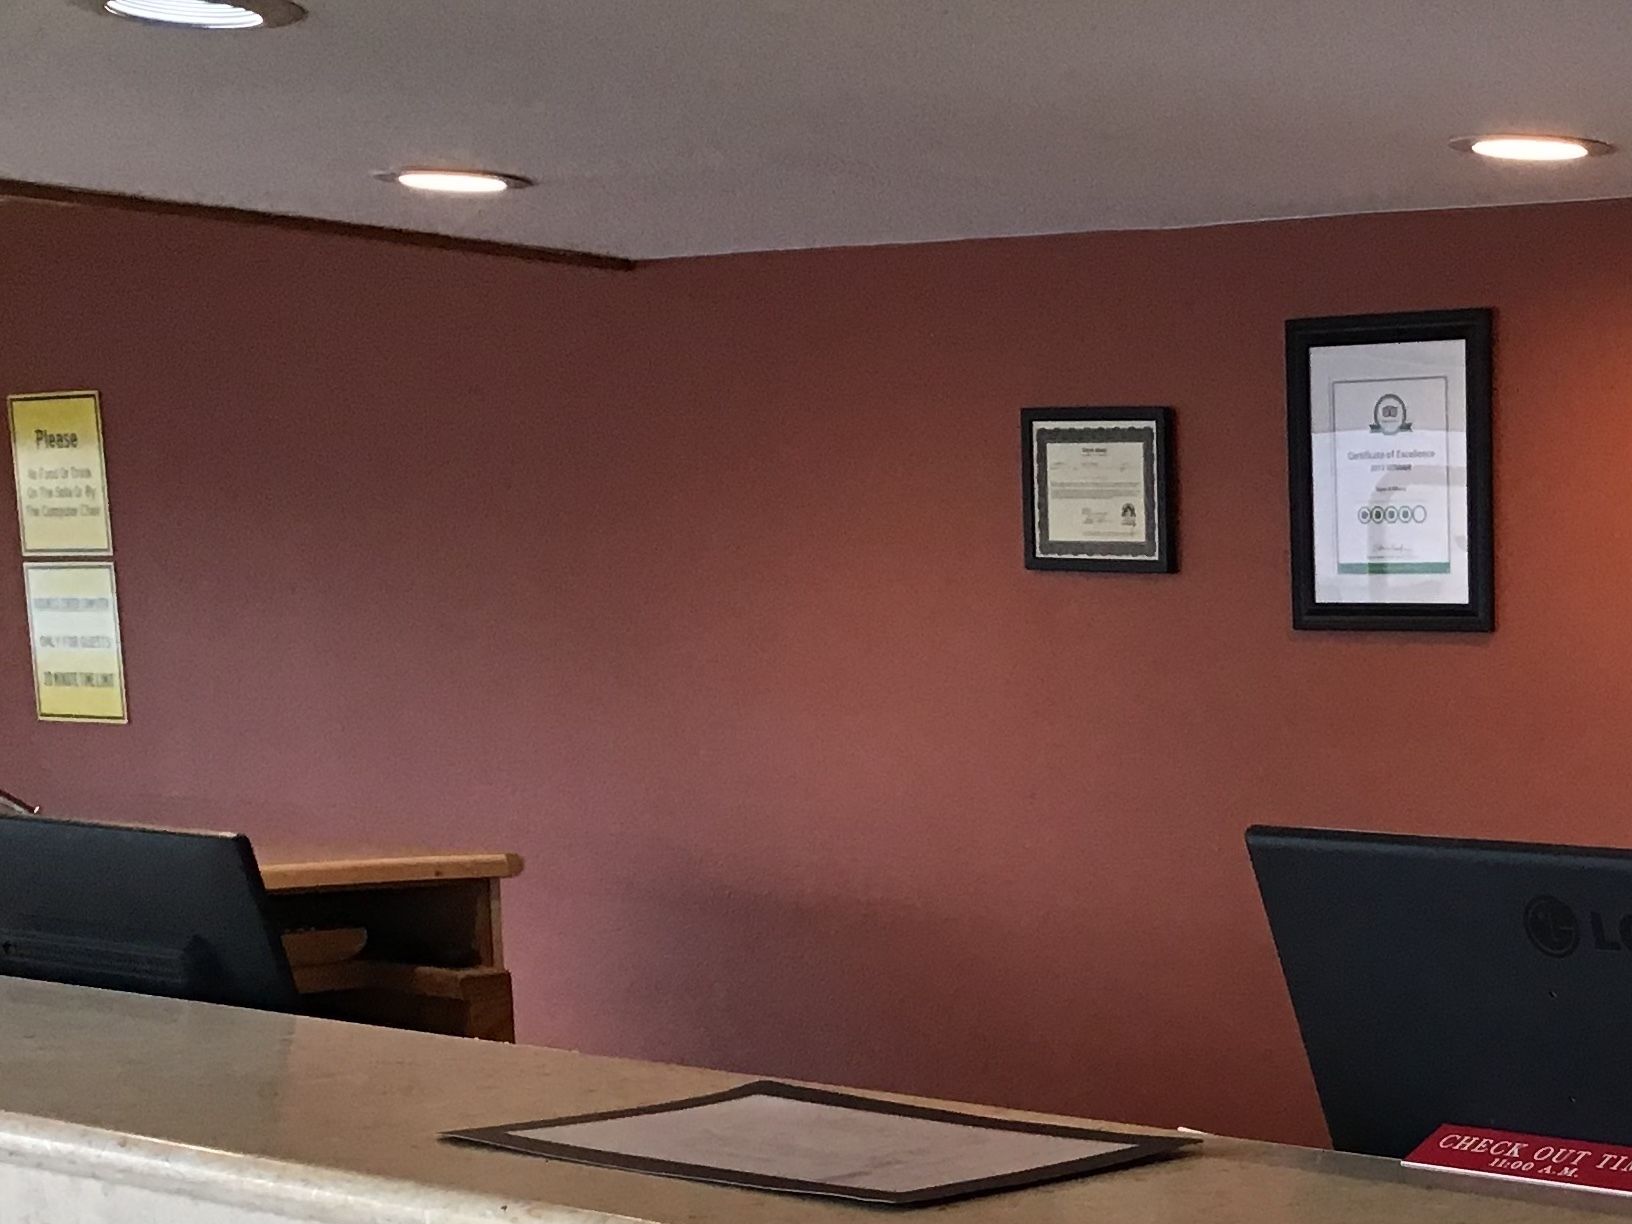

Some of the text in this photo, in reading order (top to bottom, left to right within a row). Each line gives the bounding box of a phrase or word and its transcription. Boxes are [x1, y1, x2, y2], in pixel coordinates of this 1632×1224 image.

[35, 429, 78, 450] Please
[1439, 1134, 1528, 1158] CHECK
[1533, 1146, 1592, 1166] OUT
[1488, 1157, 1580, 1178] 11:00 A.M.
